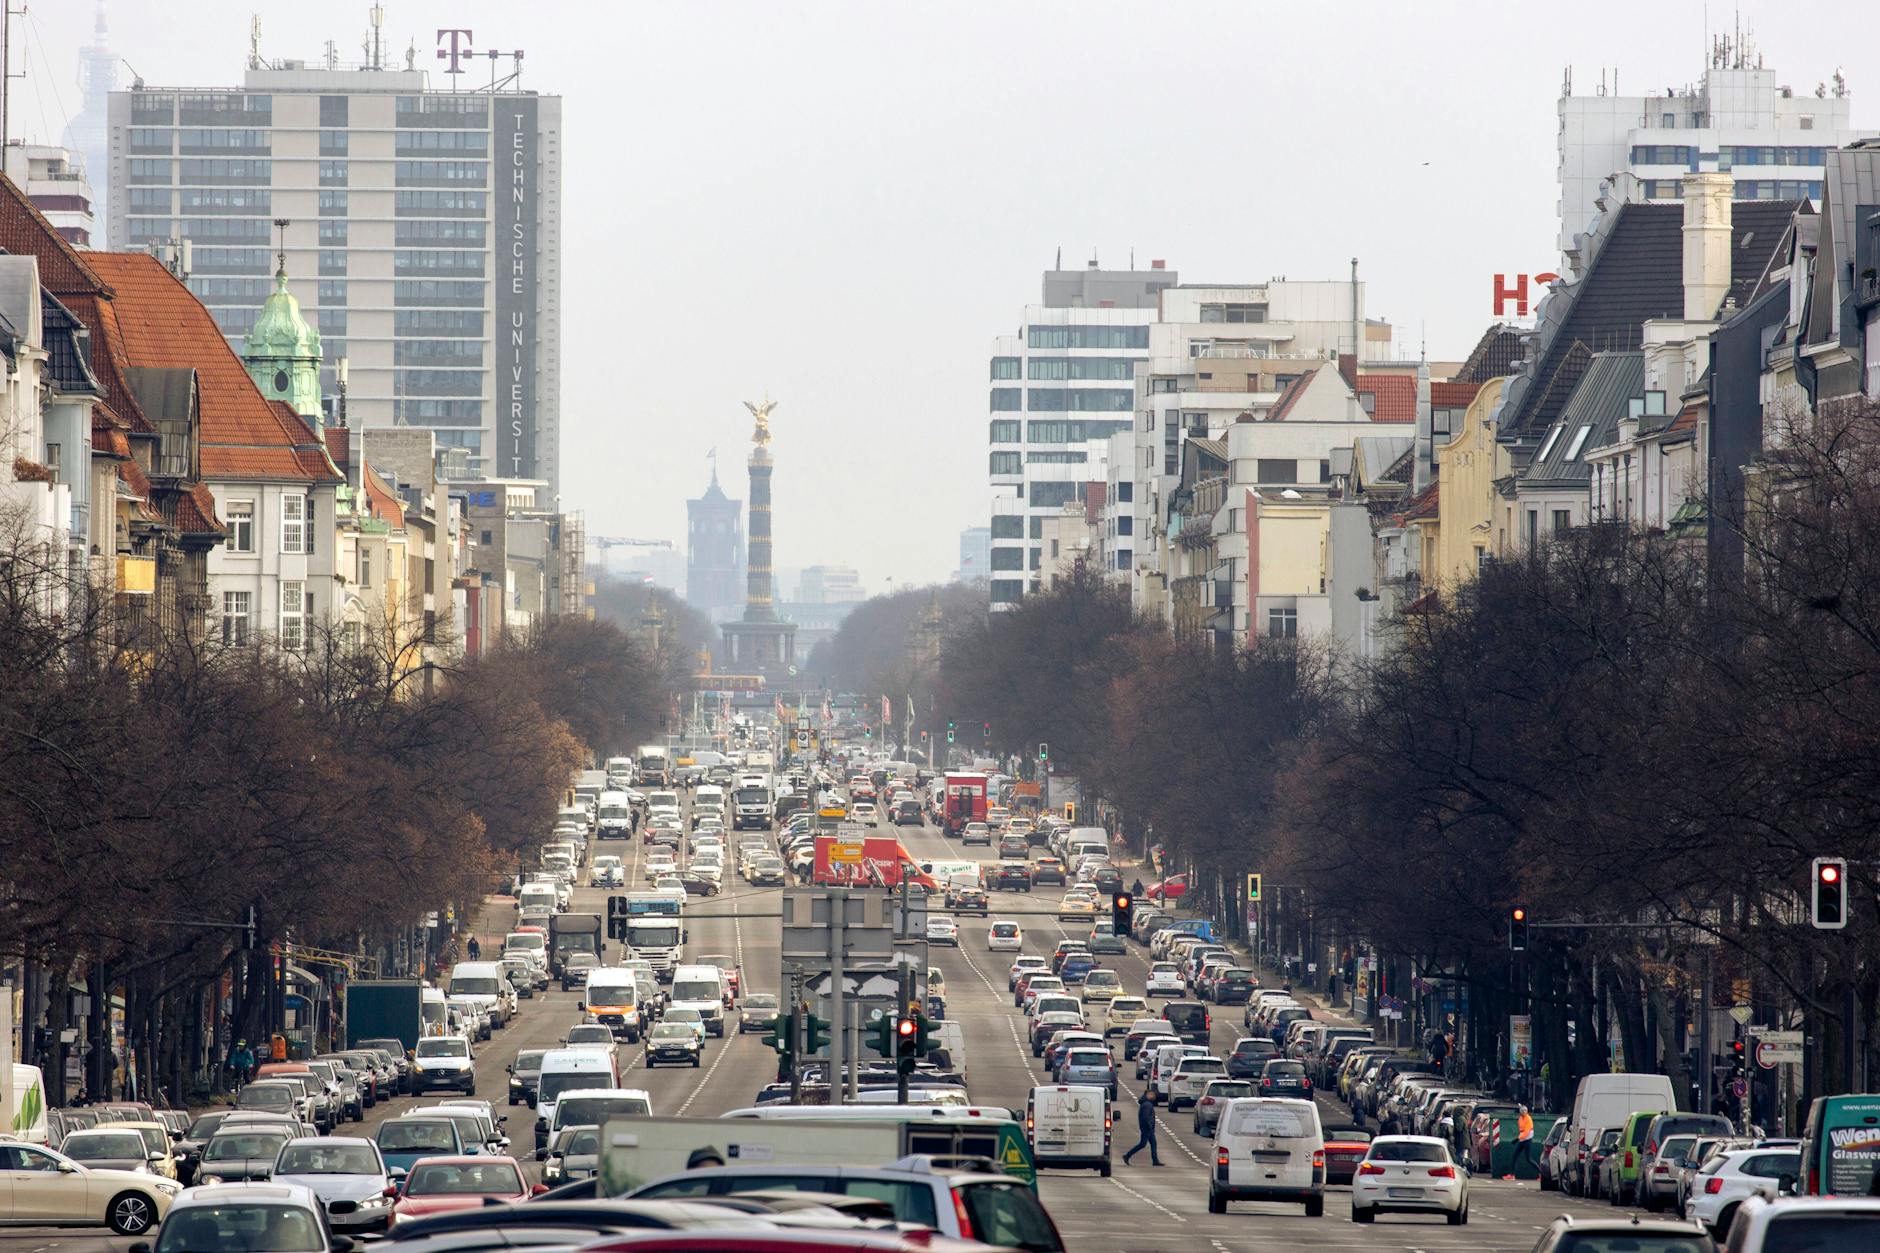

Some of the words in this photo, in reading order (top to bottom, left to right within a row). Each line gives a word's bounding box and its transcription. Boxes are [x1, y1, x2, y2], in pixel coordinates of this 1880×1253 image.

[512, 114, 524, 294] TECHNISCHE
[511, 312, 523, 479] UNIVERSIT
[789, 664, 797, 676] S
[1047, 1097, 1091, 1113] HAJO
